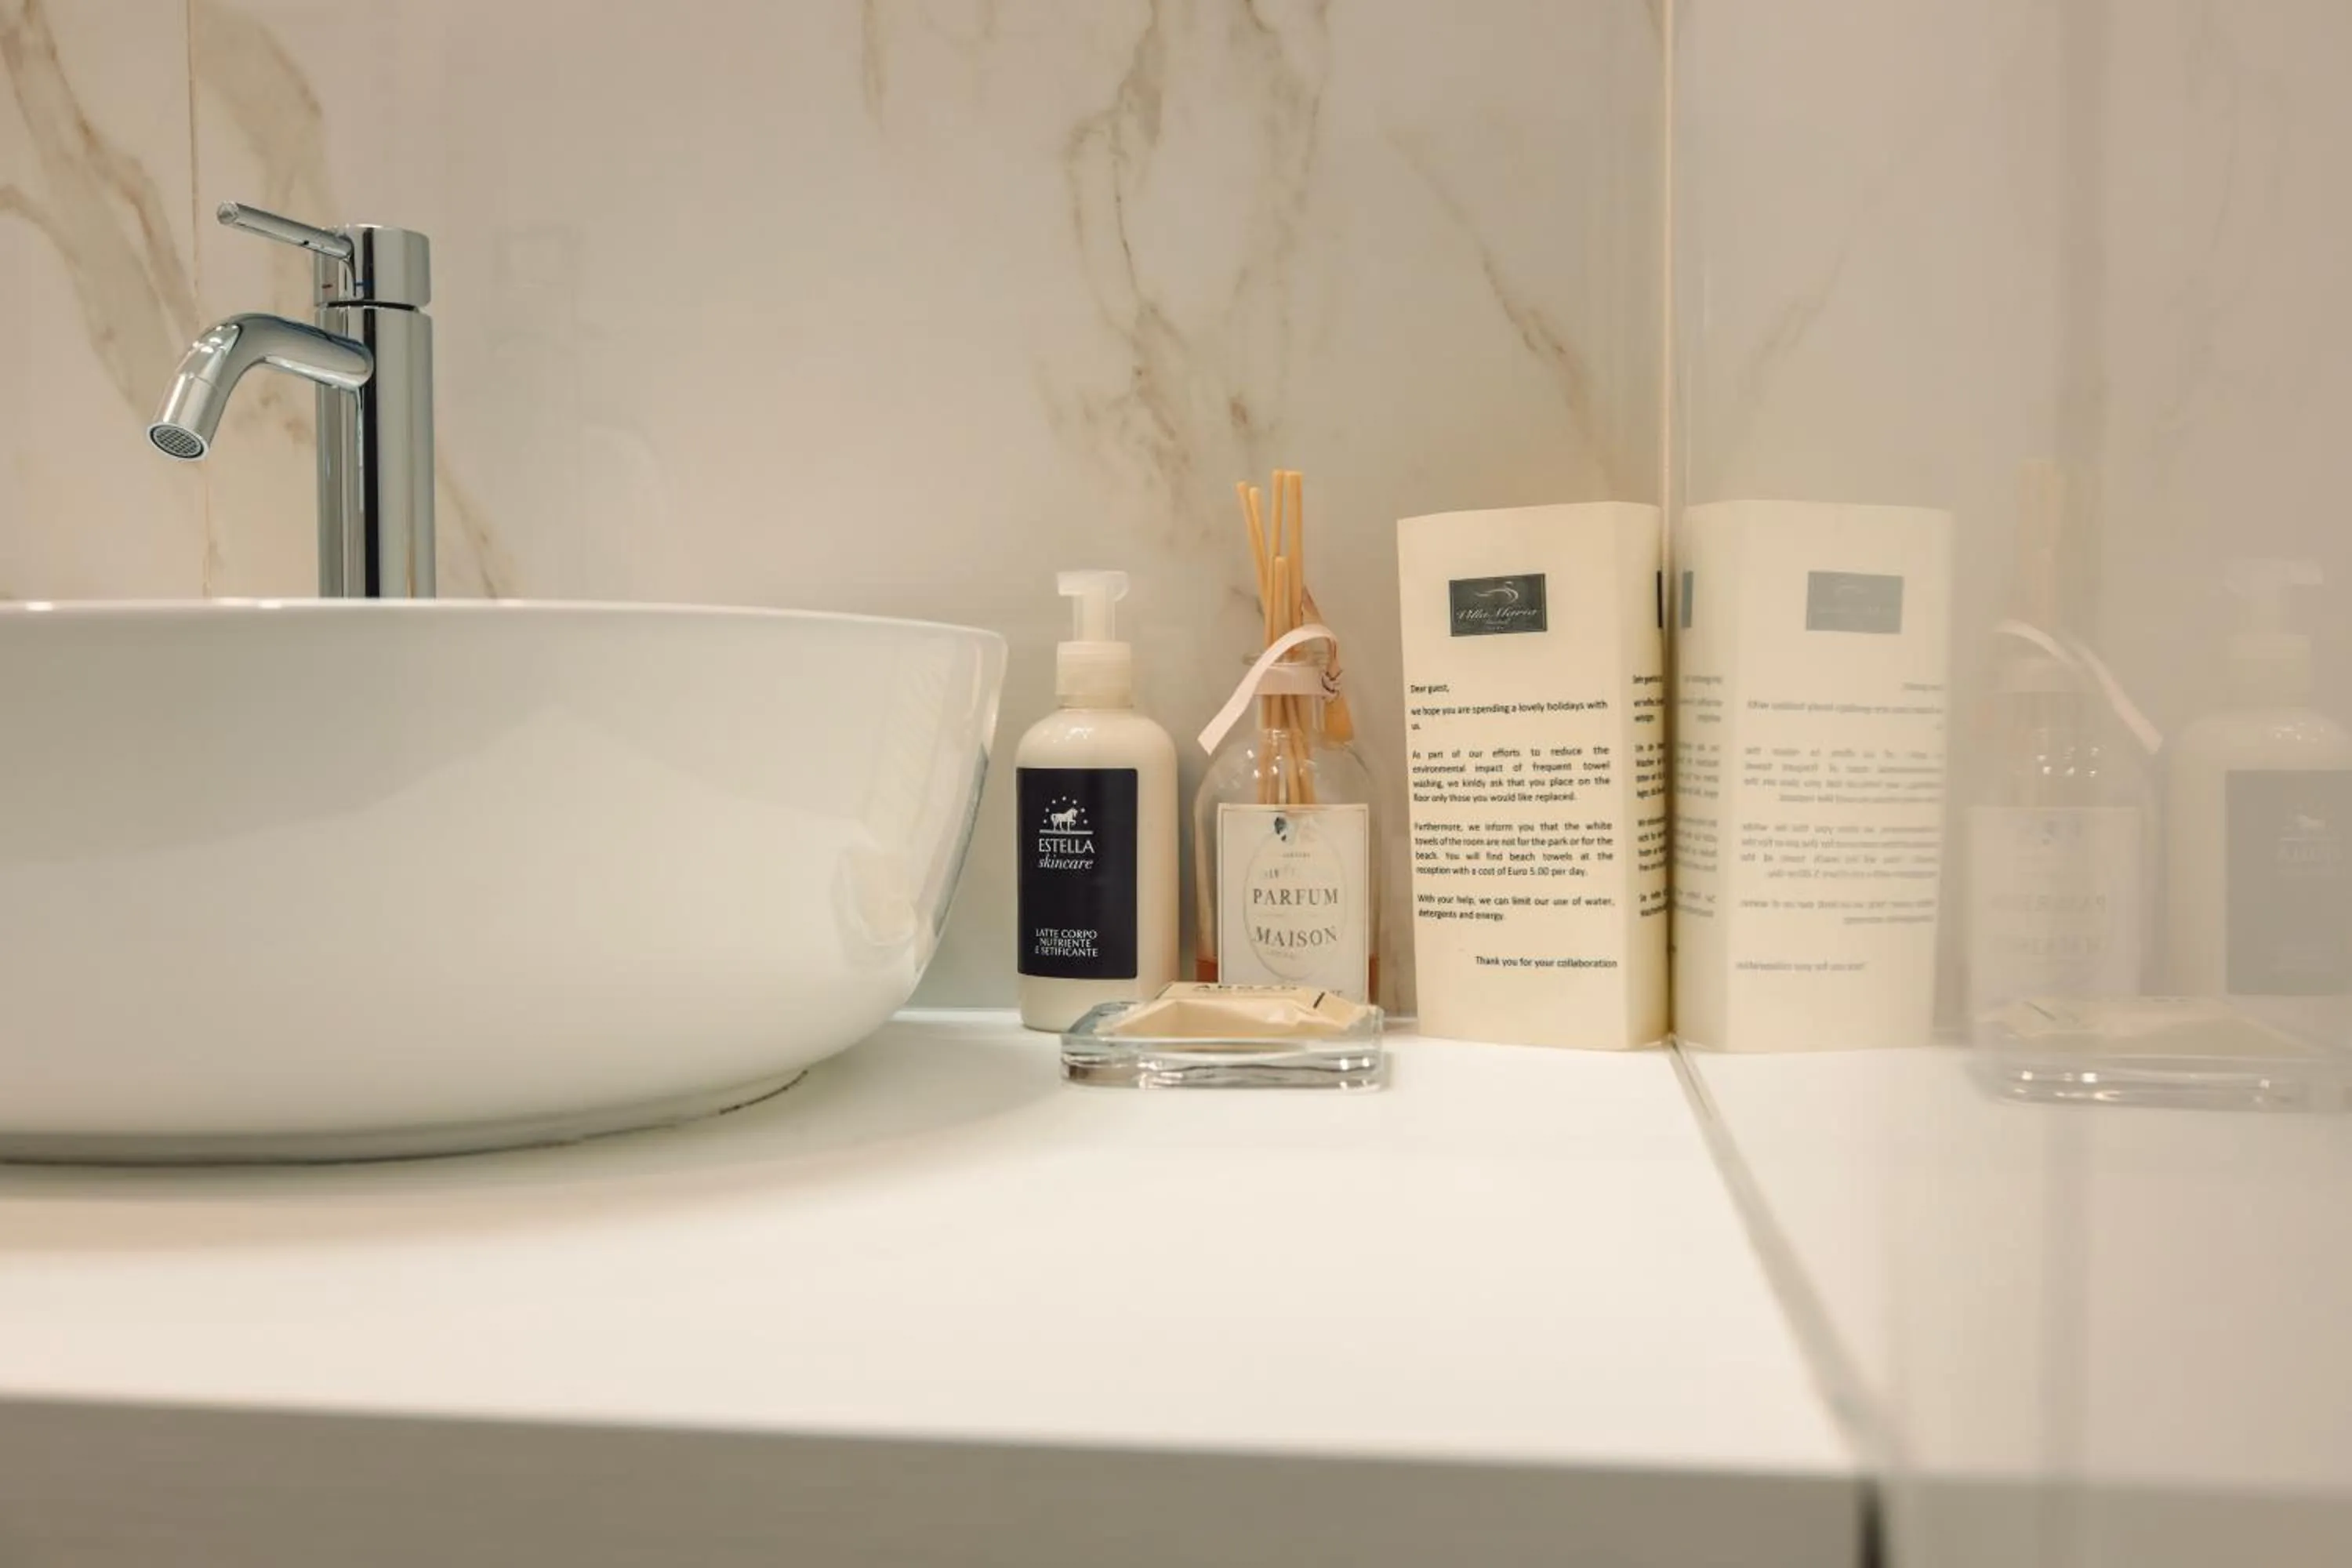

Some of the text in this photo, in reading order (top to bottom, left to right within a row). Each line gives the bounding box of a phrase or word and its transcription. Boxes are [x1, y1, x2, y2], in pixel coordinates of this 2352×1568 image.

[1428, 684, 1450, 695] guest,
[1422, 706, 1441, 716] hope
[1472, 704, 1510, 715] spending
[1518, 702, 1544, 713] lovely
[1546, 702, 1584, 711] holidays
[1586, 700, 1608, 709] with
[1413, 750, 1421, 759] As
[1428, 751, 1443, 760] part
[1451, 750, 1461, 758] of
[1492, 748, 1521, 758] efforts
[1550, 746, 1583, 756] reduce
[1593, 746, 1610, 755] the
[1413, 760, 1610, 774] environmental impact of frequent towel
[1413, 779, 1444, 789] washing,
[1490, 779, 1504, 787] ask
[1506, 778, 1526, 787] that
[1528, 779, 1546, 788] you
[1549, 777, 1574, 787] place
[1594, 776, 1611, 785] the
[1414, 793, 1430, 802] floor
[1431, 793, 1448, 803] only
[1490, 793, 1516, 802] would
[1517, 793, 1534, 802] like
[1534, 792, 1577, 803] replaced.
[1414, 822, 1464, 832] Furthermore,
[1485, 822, 1513, 831] inform
[1517, 824, 1534, 833] you
[1540, 822, 1559, 831] that
[1564, 822, 1581, 830] the
[1585, 822, 1613, 830] white
[1039, 838, 1095, 854] ESTELLA
[1415, 837, 1439, 846] towels
[1449, 837, 1462, 846] the
[1517, 837, 1530, 846] for
[1531, 837, 1547, 846] the
[1548, 837, 1569, 848] park
[1581, 836, 1595, 845] for
[1596, 837, 1613, 845] the
[1038, 853, 1094, 869] skincare
[1415, 851, 1439, 860] beach.
[1445, 852, 1461, 861] You
[1465, 851, 1481, 860] will
[1486, 851, 1503, 861] find
[1508, 851, 1535, 862] beach
[1542, 852, 1573, 862] towels
[1597, 851, 1613, 860] the
[1416, 866, 1451, 876] reception
[1451, 866, 1471, 875] with
[1479, 867, 1496, 876] cost
[1497, 866, 1507, 876] of
[1508, 866, 1529, 876] Euro
[1530, 866, 1550, 876] 5.00
[1551, 869, 1567, 877] per
[1568, 867, 1588, 877] day.
[1253, 888, 1338, 906] PARFUM
[1417, 894, 1436, 903] With
[1436, 896, 1454, 905] your
[1456, 895, 1476, 906] help,
[1511, 896, 1532, 906] limit
[1572, 896, 1581, 906] of
[1418, 909, 1457, 920] detergents
[1475, 912, 1505, 922] energy.
[1036, 928, 1098, 939] LATTE CORPO
[1254, 925, 1338, 947] MAISON
[1040, 938, 1091, 948] NUTRIENTE
[1475, 956, 1501, 965] Thank
[1519, 957, 1534, 966] for
[1534, 960, 1555, 968] your
[1556, 958, 1617, 968] collaboration
